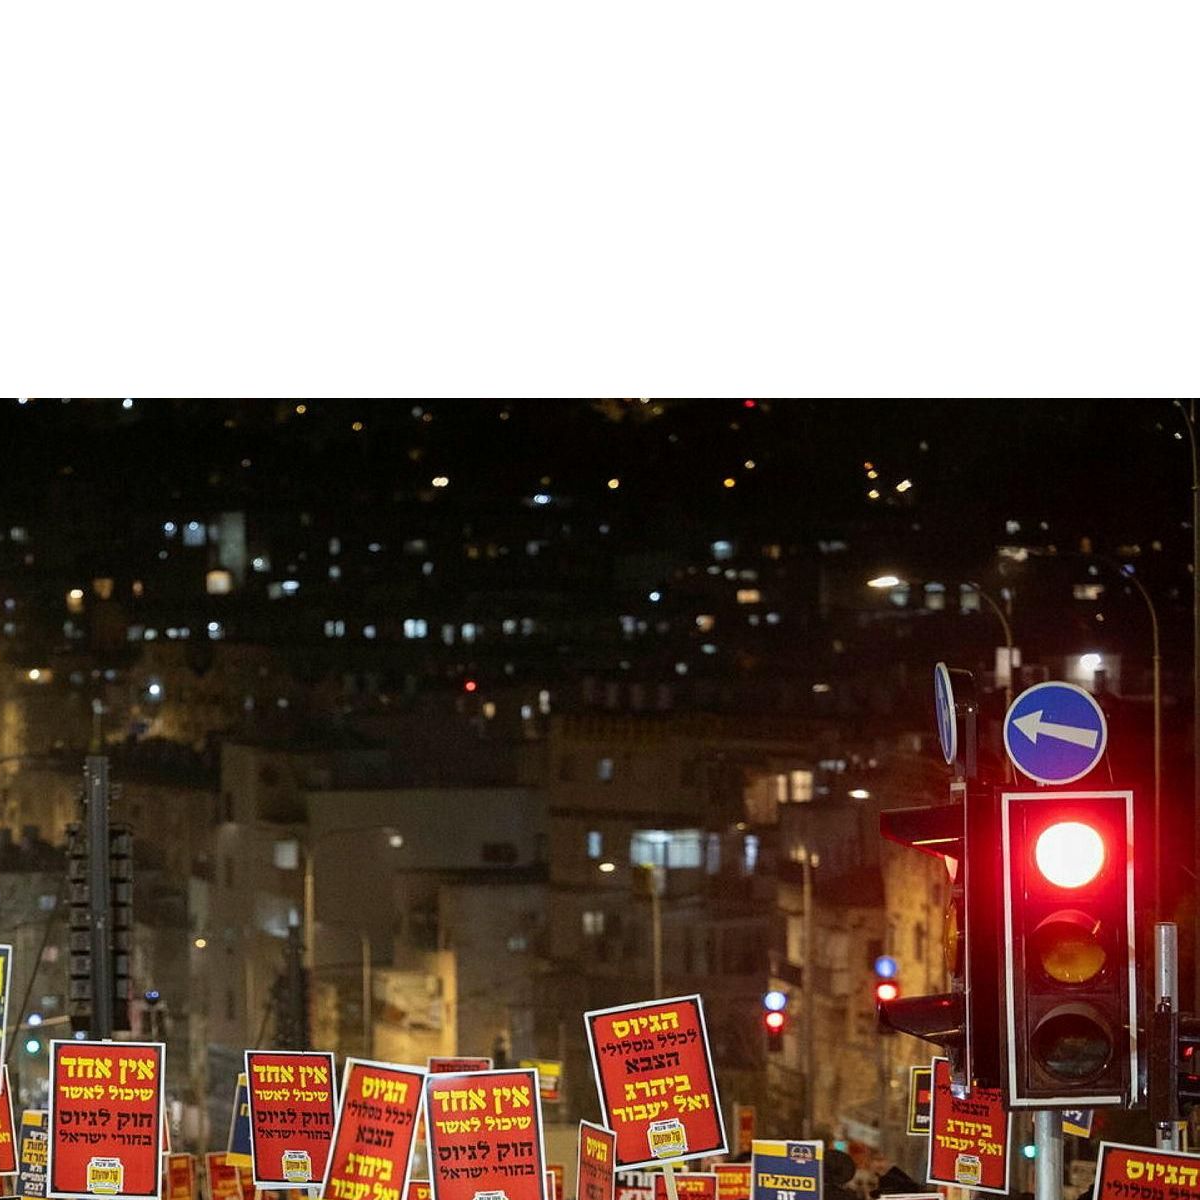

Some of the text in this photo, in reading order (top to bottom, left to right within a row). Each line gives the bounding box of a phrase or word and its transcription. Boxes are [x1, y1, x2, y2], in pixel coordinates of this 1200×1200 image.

[612, 1011, 679, 1039] הגיוס
[601, 1028, 697, 1057] לכלל מסלולי
[60, 1056, 155, 1084] אין אחד
[625, 1051, 680, 1074] הצבא
[253, 1065, 328, 1088] אין אחד
[60, 1085, 154, 1101] שיכול לאשר
[255, 1089, 328, 1102] שיכול לאשר
[361, 1076, 408, 1104] הגיוס
[624, 1074, 691, 1101] ביהרג
[433, 1086, 530, 1114] אין אחד
[612, 1092, 710, 1122] ואל יעבור
[951, 1101, 989, 1117] הצבא
[59, 1108, 152, 1130] חוק לגיוס
[256, 1108, 297, 1124] לגיוס
[302, 1112, 329, 1126] חוק
[347, 1100, 413, 1126] לכלל מסלולי
[258, 1127, 331, 1140] בחורי ישראל
[436, 1116, 531, 1134] שיכול לאשר
[947, 1119, 992, 1138] ביהרג
[59, 1130, 152, 1146] בחורי ישראל
[355, 1124, 394, 1148] הצבא
[936, 1135, 1002, 1156] ואל יעבור
[438, 1140, 533, 1161] חוק לגיוס
[345, 1152, 393, 1181] ביהרג
[440, 1164, 535, 1180] בחורי ישראל
[1126, 1159, 1199, 1187] הגיוס
[760, 1174, 812, 1188] סטאלין
[1105, 1179, 1165, 1200] מסלולי
